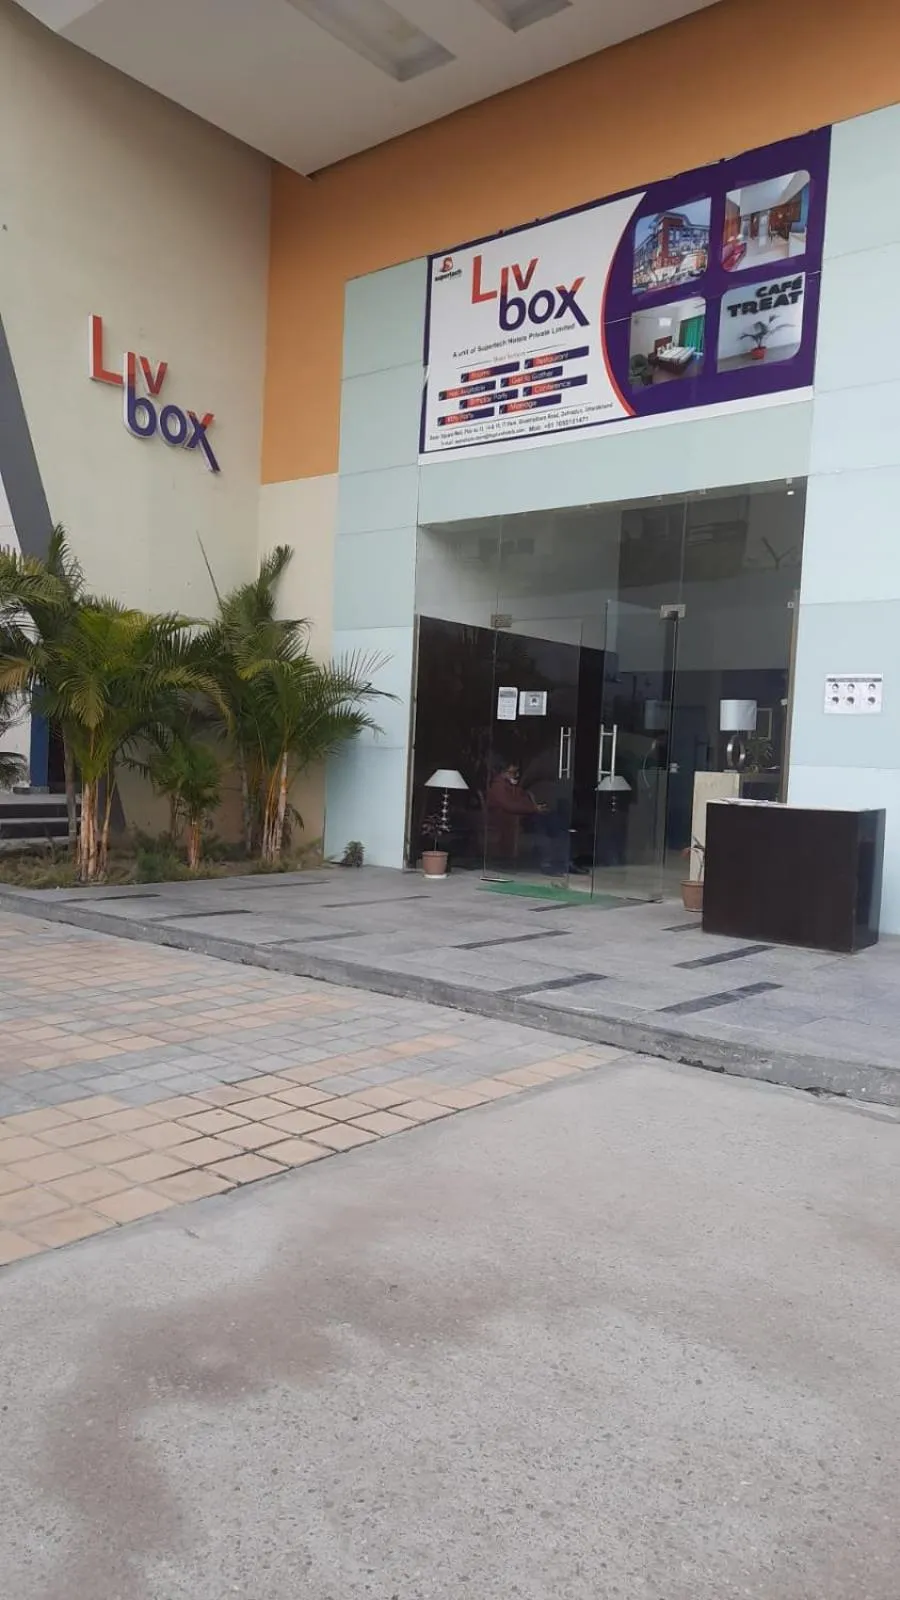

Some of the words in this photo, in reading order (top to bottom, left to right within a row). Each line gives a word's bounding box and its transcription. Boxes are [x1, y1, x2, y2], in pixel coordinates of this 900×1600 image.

[498, 276, 590, 331] box
[727, 291, 803, 317] TREAT
[458, 349, 469, 357] unit
[477, 339, 507, 352] Supertech
[528, 330, 550, 340] Private
[551, 322, 576, 335] Limited
[124, 365, 221, 473] box
